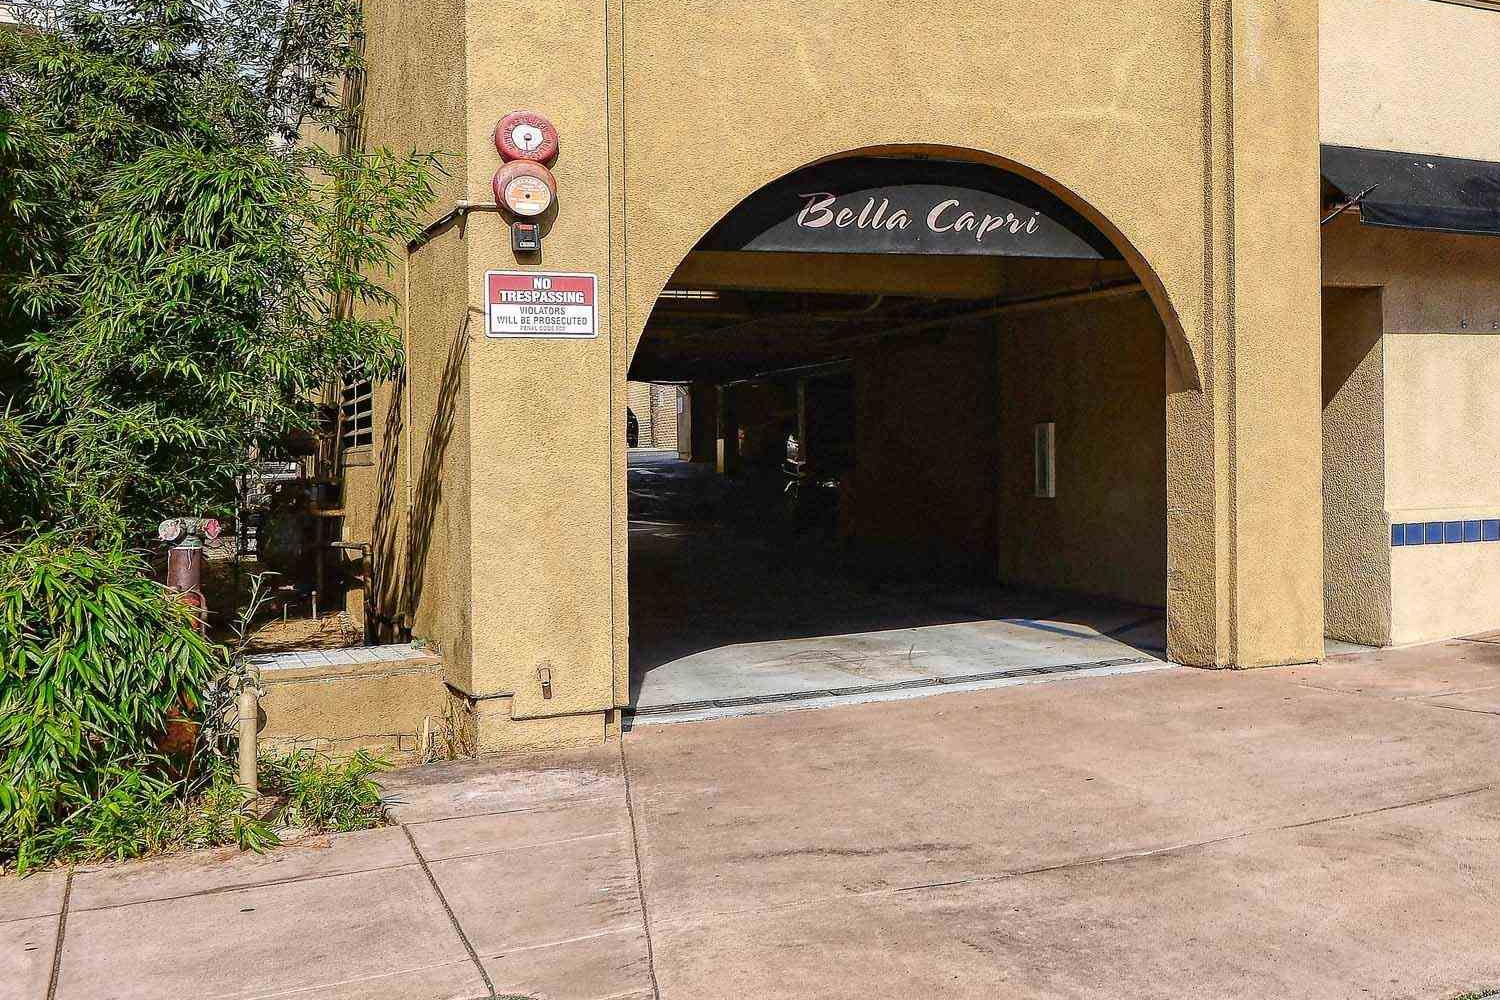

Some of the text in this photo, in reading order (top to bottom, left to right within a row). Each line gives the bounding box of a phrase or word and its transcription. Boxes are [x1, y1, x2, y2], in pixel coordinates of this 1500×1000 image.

[797, 192, 1041, 242] Bella Capri
[533, 277, 552, 290] NO
[499, 290, 585, 304] TRESPASSING
[519, 306, 566, 315] VIOLATORS
[496, 316, 588, 325] WILL BE PROSECUTED
